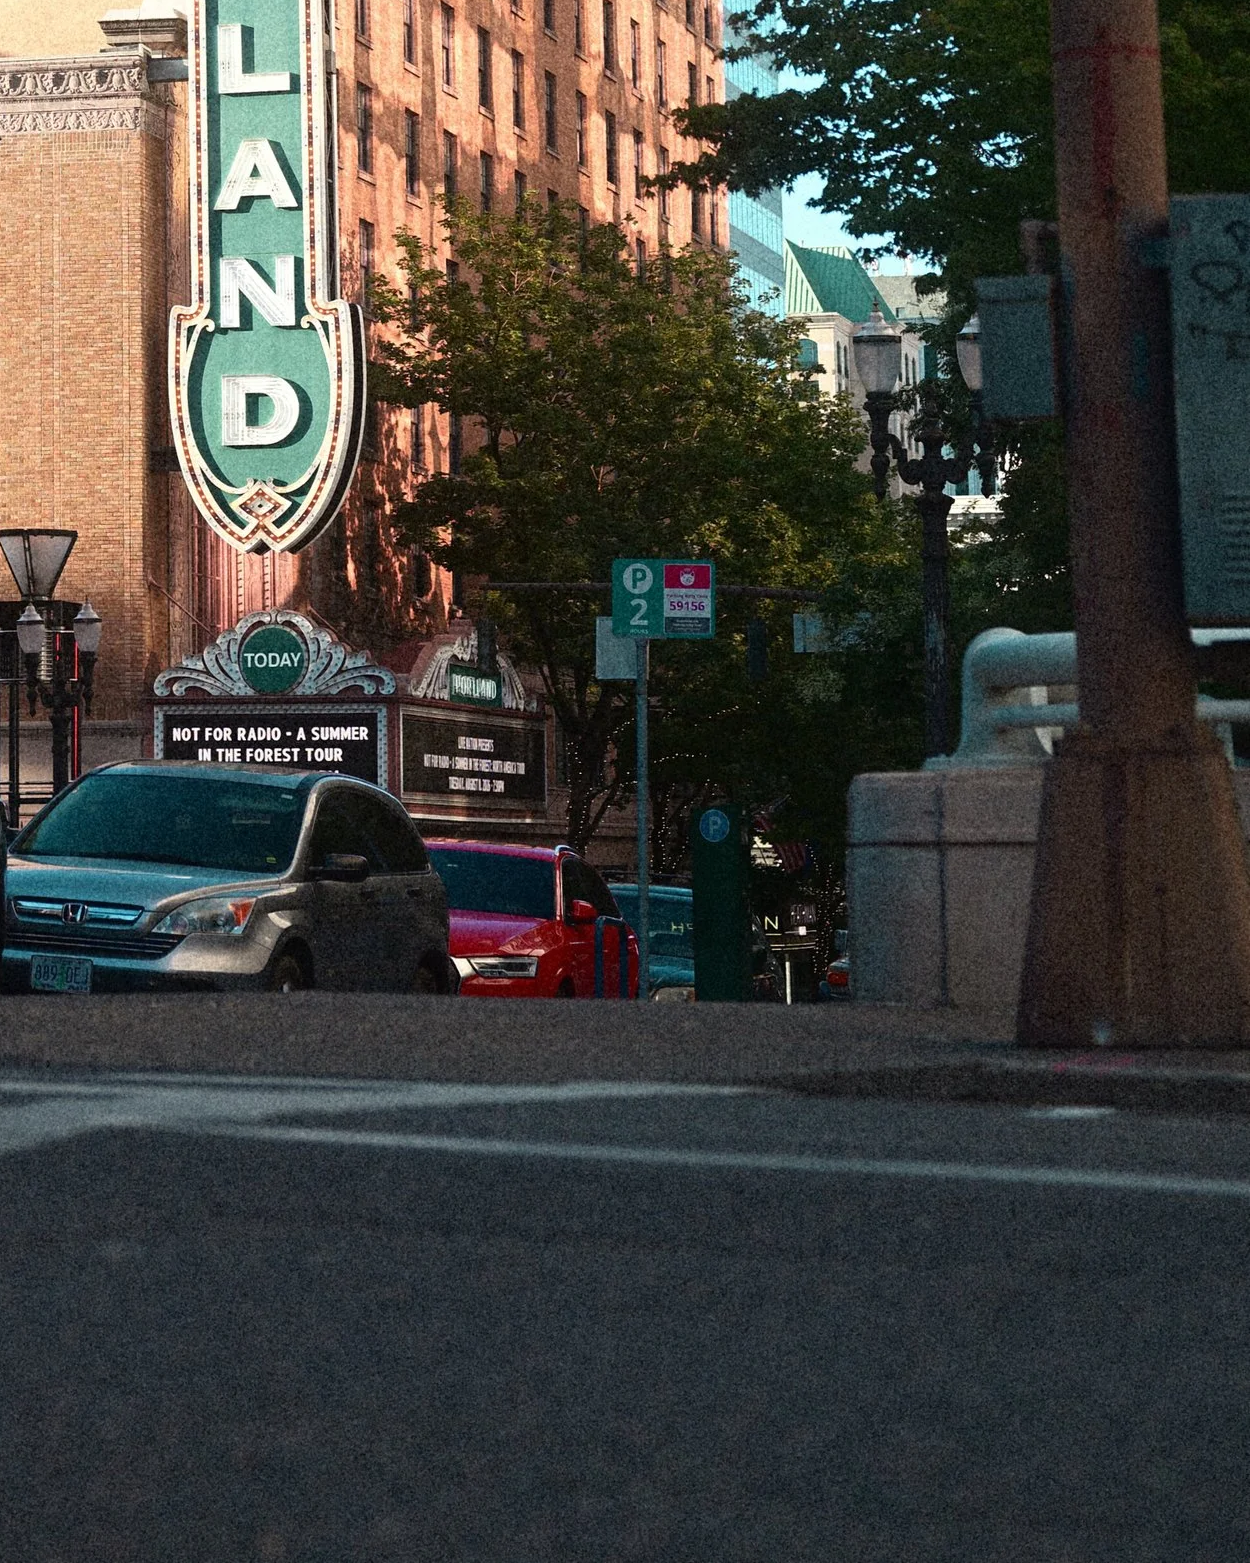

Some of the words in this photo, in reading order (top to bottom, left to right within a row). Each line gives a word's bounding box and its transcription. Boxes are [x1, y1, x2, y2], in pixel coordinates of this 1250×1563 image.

[630, 598, 649, 626] 2
[669, 600, 705, 611] 59156
[243, 652, 301, 668] TODAY
[452, 674, 497, 700] PORTLAND
[172, 727, 200, 742] NOT
[205, 727, 232, 742] FOR
[237, 727, 281, 741] RADIO
[296, 727, 306, 741] A
[311, 726, 369, 741] SUMMER
[198, 748, 212, 762] IN
[216, 748, 242, 762] THE
[246, 748, 300, 762] FOREST
[305, 748, 343, 762] TOUR
